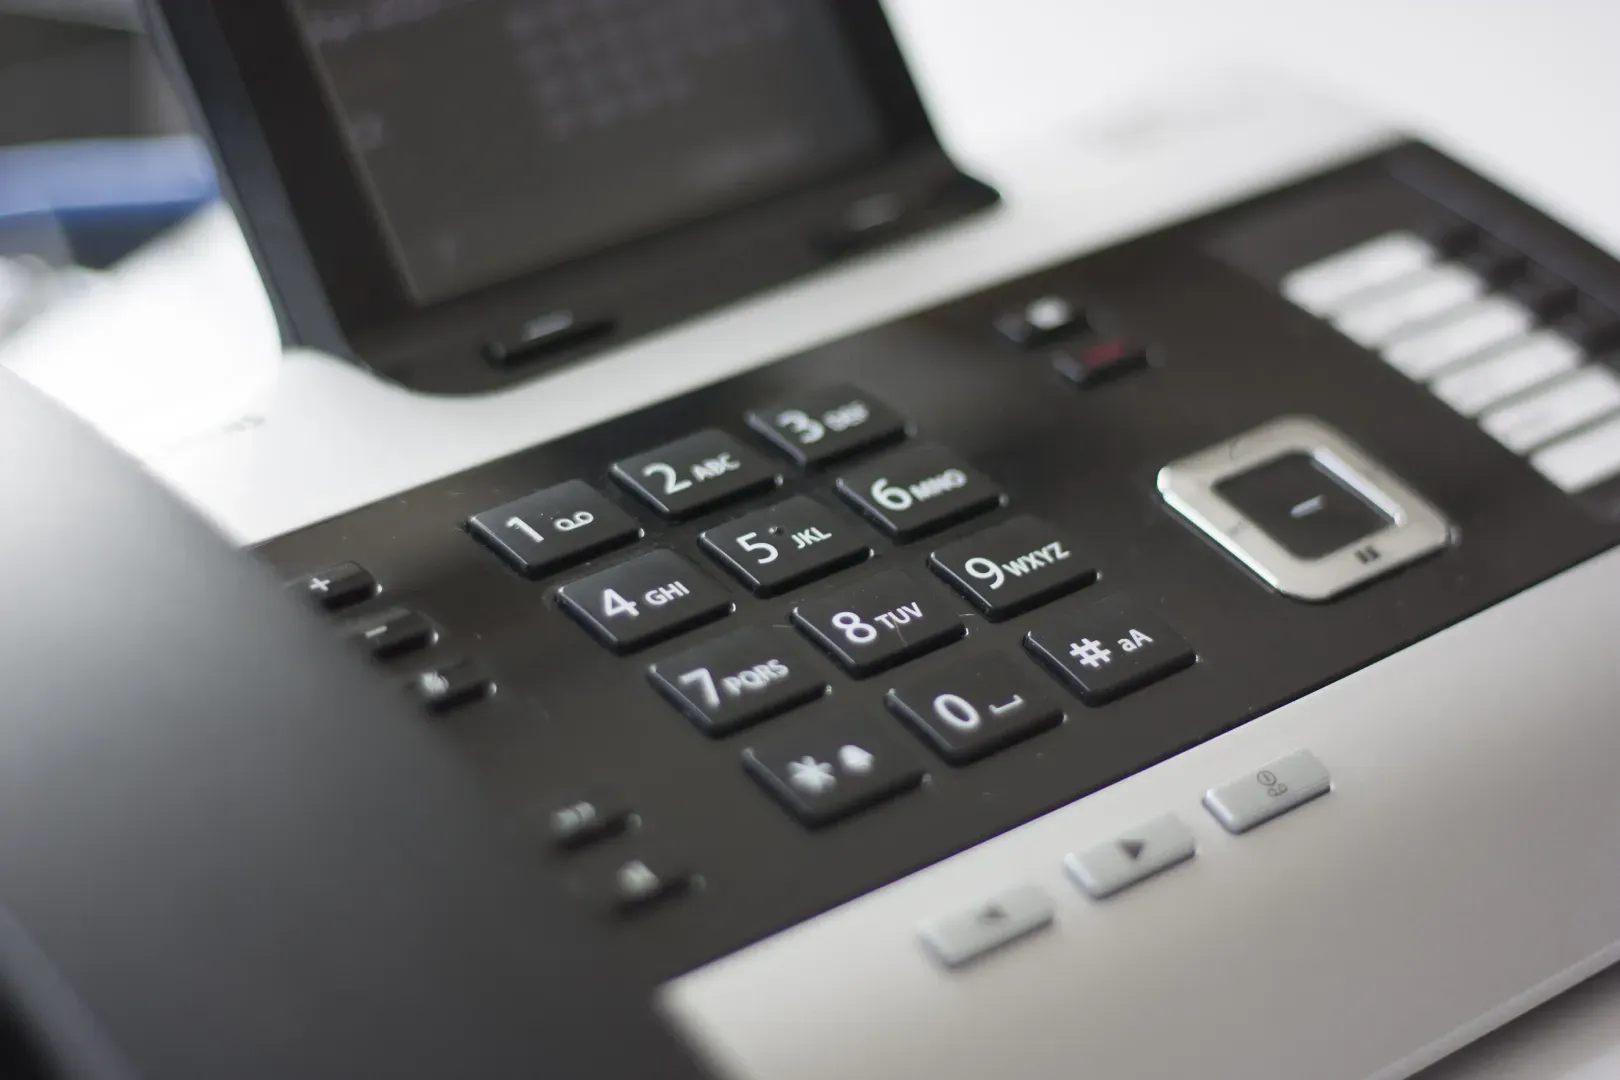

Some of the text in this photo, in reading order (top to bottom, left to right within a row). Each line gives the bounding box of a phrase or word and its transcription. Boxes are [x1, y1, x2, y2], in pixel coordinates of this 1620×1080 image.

[779, 410, 825, 444] 3
[643, 453, 741, 495] 2 ABC
[871, 478, 914, 511] 6
[505, 516, 545, 543] 1
[735, 526, 833, 564] 5 JKL
[964, 541, 1070, 590] 9 WXYZ
[602, 580, 691, 617] 4 GHI
[831, 601, 923, 644] 8 TUV
[1068, 628, 1154, 668] # aA
[678, 658, 790, 708] 7 PQRS
[933, 693, 981, 730] 0
